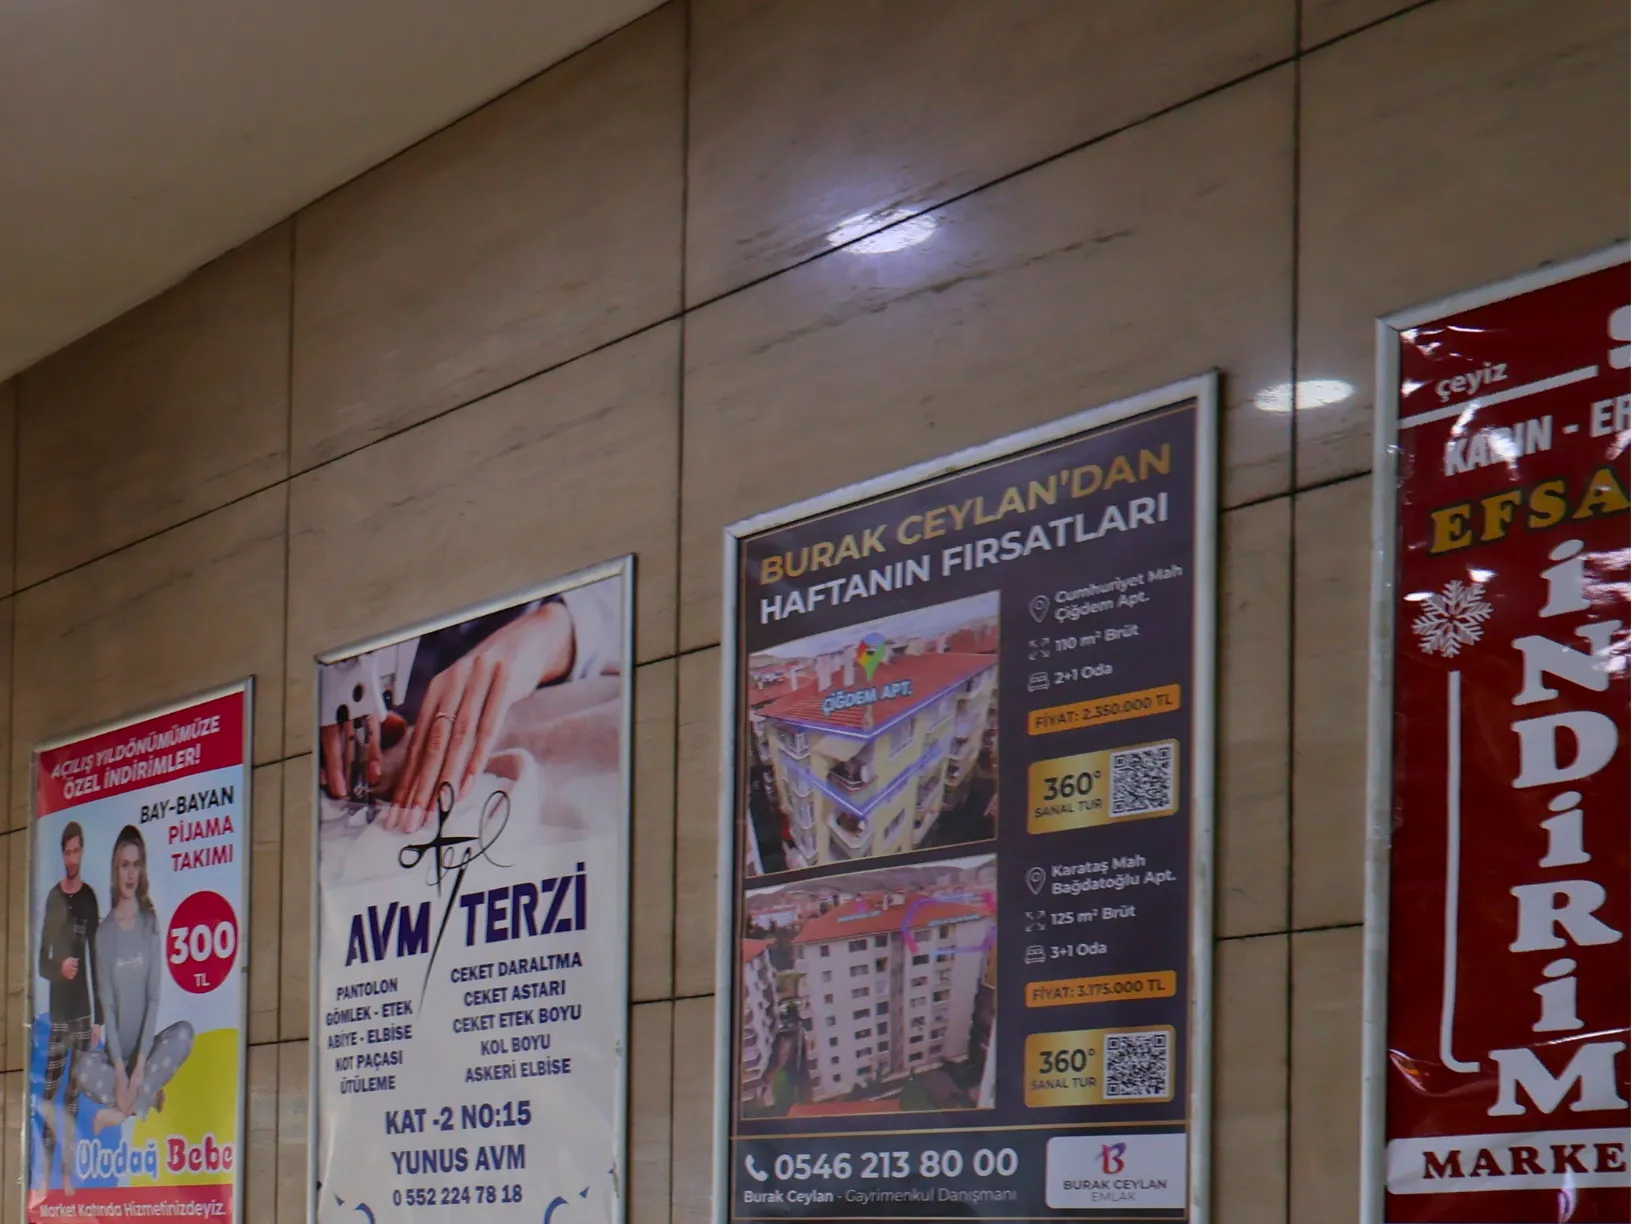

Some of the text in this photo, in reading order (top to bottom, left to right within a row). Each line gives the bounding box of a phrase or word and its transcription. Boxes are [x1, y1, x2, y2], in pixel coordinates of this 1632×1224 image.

[1436, 361, 1508, 402] çeyiz
[760, 443, 1171, 585] BURAK CEYLAN'DAN
[760, 492, 1168, 625] HAFTANIN FIRSATLARI
[1054, 564, 1183, 604] Cumhuriyet Mah
[1054, 590, 1150, 623] Çiğdem Apt.
[1056, 636, 1078, 652] 110
[1104, 624, 1140, 642] Brüt
[1054, 664, 1113, 685] 2+1 Oda
[1035, 708, 1079, 729] FİYAT:
[1156, 694, 1172, 707] TL
[51, 715, 220, 780] AÇILIŞ YILDÖNÜMÜMÜZE
[63, 744, 201, 800] ÖZEL İNDİRİMLER!
[140, 785, 234, 824] BAY-BAYAN
[1035, 798, 1102, 818] SANAL TUR
[168, 815, 234, 845] PİJAMA
[172, 844, 233, 872] TAKIMI
[1051, 854, 1146, 878] Karataş Mah
[1052, 869, 1177, 895] Bağdatoğlu Apt.
[345, 861, 587, 967] AVM TERZİ
[1050, 912, 1074, 925] 125
[1101, 905, 1136, 920] Brüt
[170, 921, 235, 965] 300
[1050, 942, 1107, 959] 3+1 Oda
[193, 973, 210, 987] TL
[451, 952, 582, 983] CEKET DARALTMA
[337, 978, 398, 1001] PANTOLON
[464, 980, 566, 1006] CEKET ASTARI
[1032, 986, 1075, 1001] FİYAT:
[1148, 979, 1165, 991] TL
[326, 1003, 371, 1027] GÖMLEK
[382, 1000, 413, 1018] ETEK
[453, 1004, 582, 1033] CEKET ETEK BOYU
[327, 1032, 357, 1050] ABİYE
[367, 1024, 412, 1043] ELBİSE
[481, 1034, 551, 1056] KOL BOYU
[335, 1051, 403, 1071] KOT PAÇASI
[465, 1057, 571, 1083] ASKERİ ELBİSE
[340, 1075, 396, 1094] ÜTÜLEME
[1030, 1077, 1096, 1090] SANAL TUR
[386, 1100, 532, 1135] KAT -2 NO:15
[167, 1135, 233, 1172] Bebe
[392, 1144, 526, 1175] YUNUS AVM
[774, 1147, 1018, 1181] 0546 213 80 00
[1423, 1143, 1627, 1179] MARKE
[393, 1184, 522, 1206] 0 552 224 78 18
[744, 1190, 784, 1204] Burak
[787, 1188, 834, 1205] Ceylan
[845, 1187, 934, 1205] Gayrimenkul
[939, 1187, 1017, 1205] Danışmanı
[1063, 1178, 1167, 1190] BURAK CEYLAN
[1091, 1191, 1136, 1202] EMLAK
[41, 1203, 75, 1217] Market
[78, 1203, 122, 1216] Katında
